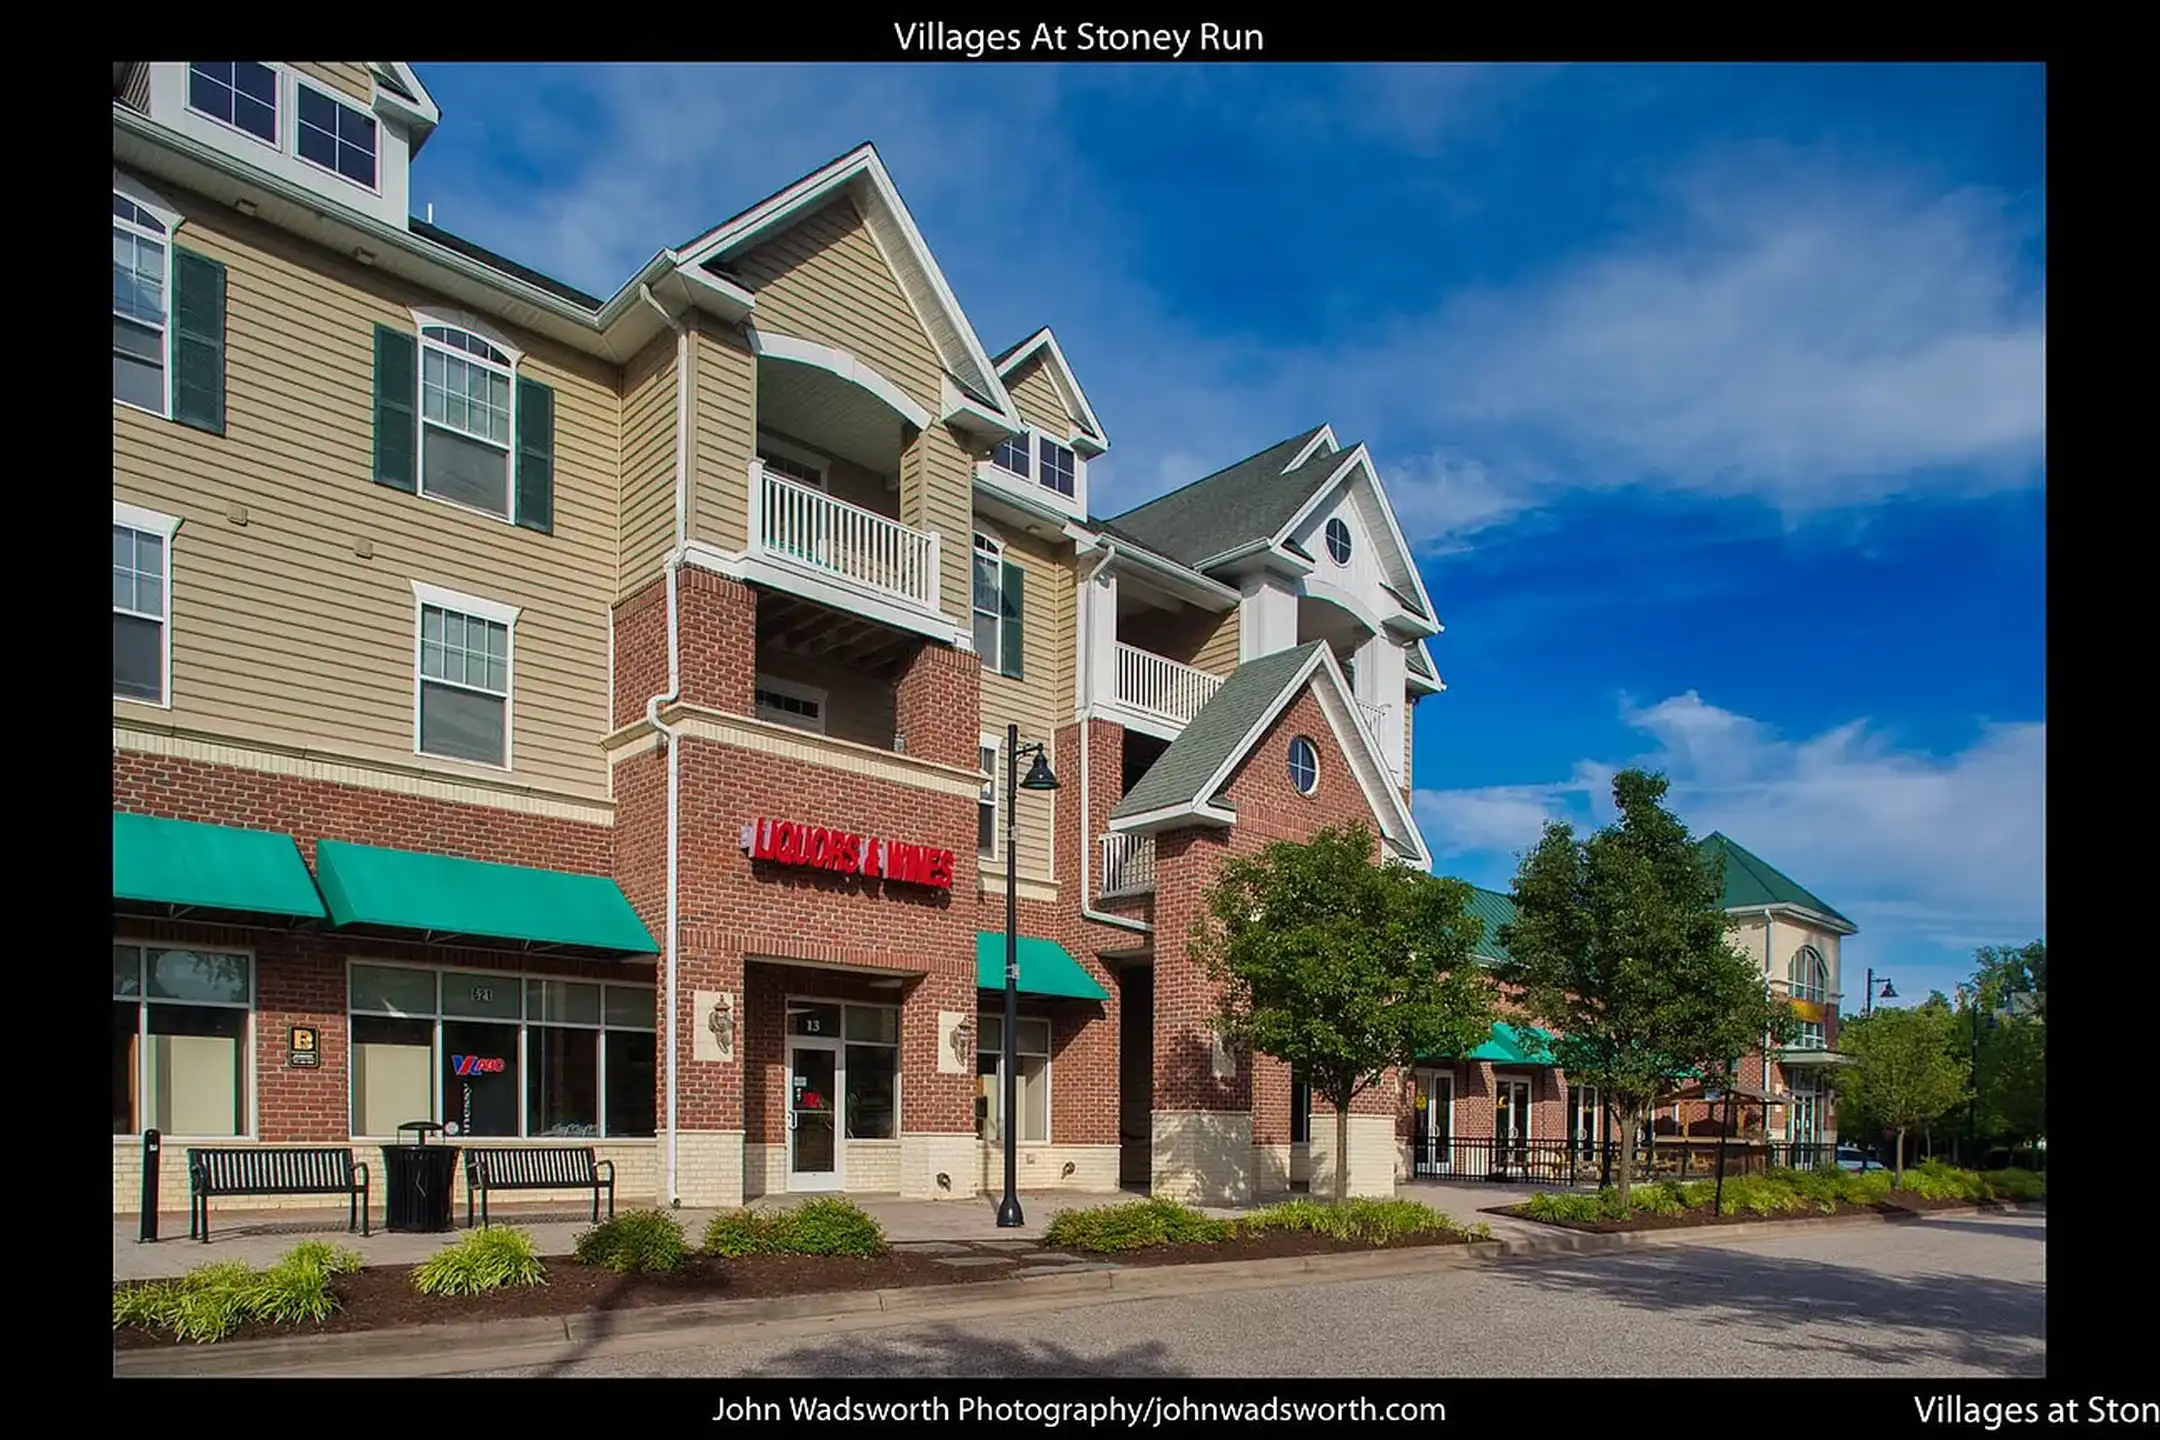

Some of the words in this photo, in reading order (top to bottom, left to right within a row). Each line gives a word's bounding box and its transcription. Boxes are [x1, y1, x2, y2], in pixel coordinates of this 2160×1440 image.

[752, 816, 861, 875] LIQUORS
[863, 836, 881, 877] &
[885, 840, 956, 888] WINES
[806, 1019, 821, 1032] 13
